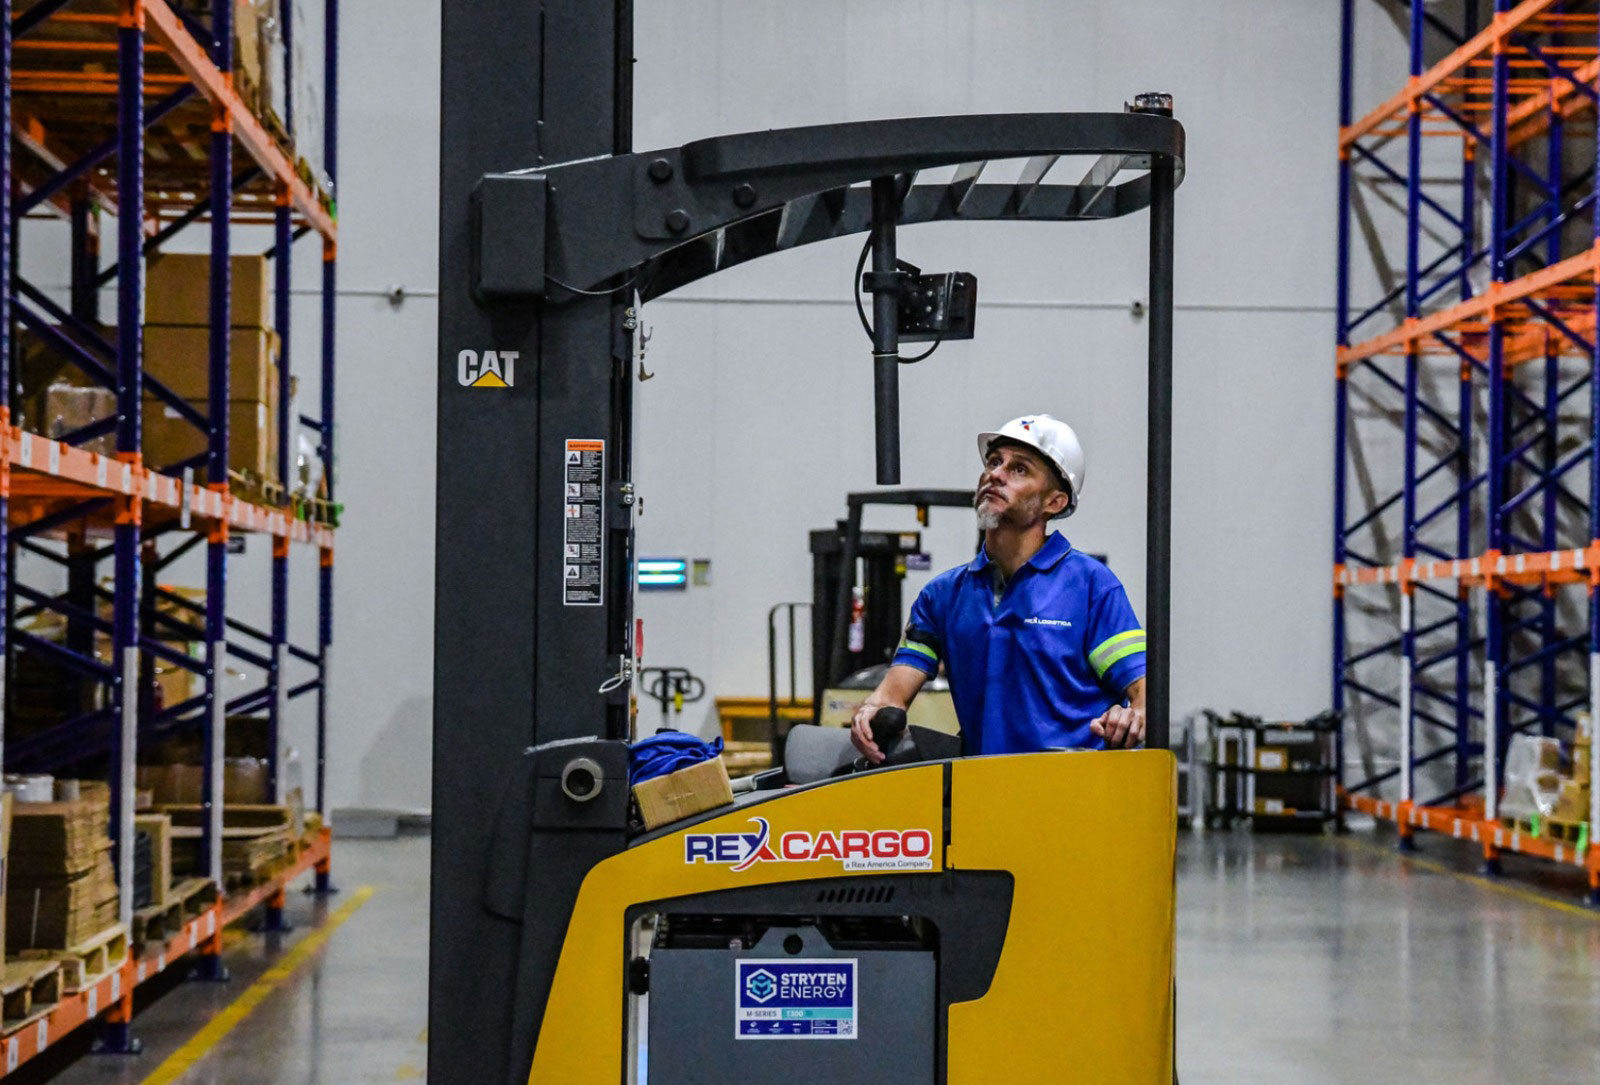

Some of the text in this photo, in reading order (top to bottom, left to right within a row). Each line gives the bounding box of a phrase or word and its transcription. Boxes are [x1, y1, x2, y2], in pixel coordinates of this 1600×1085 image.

[458, 349, 520, 387] CAT
[686, 817, 931, 871] REX CARGO
[867, 860, 896, 868] America
[897, 860, 931, 869] Company
[781, 973, 847, 985] STRYTEN
[780, 986, 847, 999] ENERGY
